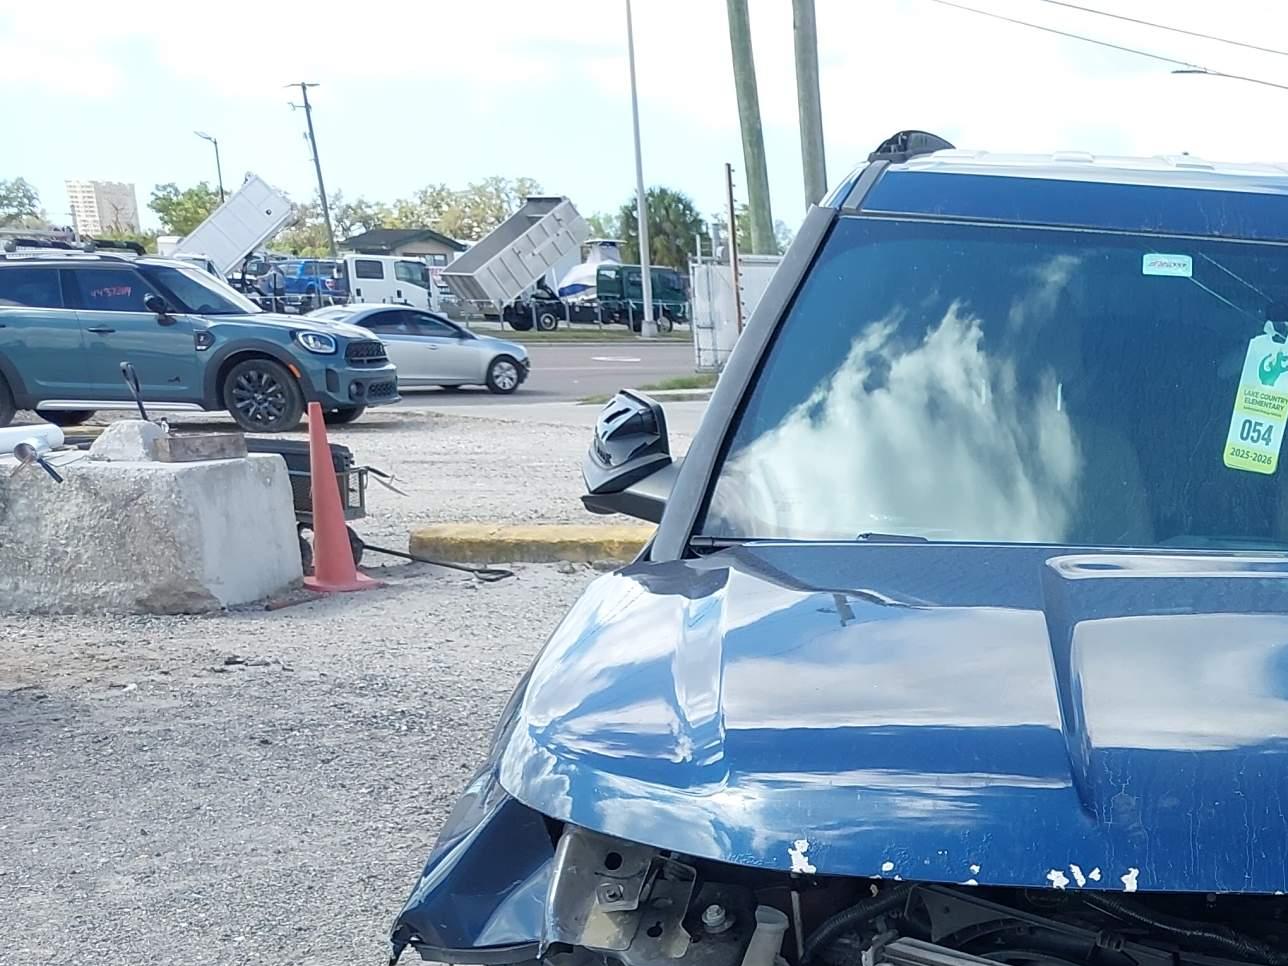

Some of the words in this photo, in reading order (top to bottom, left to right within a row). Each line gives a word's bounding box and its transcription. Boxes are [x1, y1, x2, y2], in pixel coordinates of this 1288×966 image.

[1244, 389, 1259, 398] LAKE
[1244, 397, 1285, 411] ELEMENTARY
[1240, 419, 1274, 446] 054
[1230, 448, 1272, 464] 2025-2026
